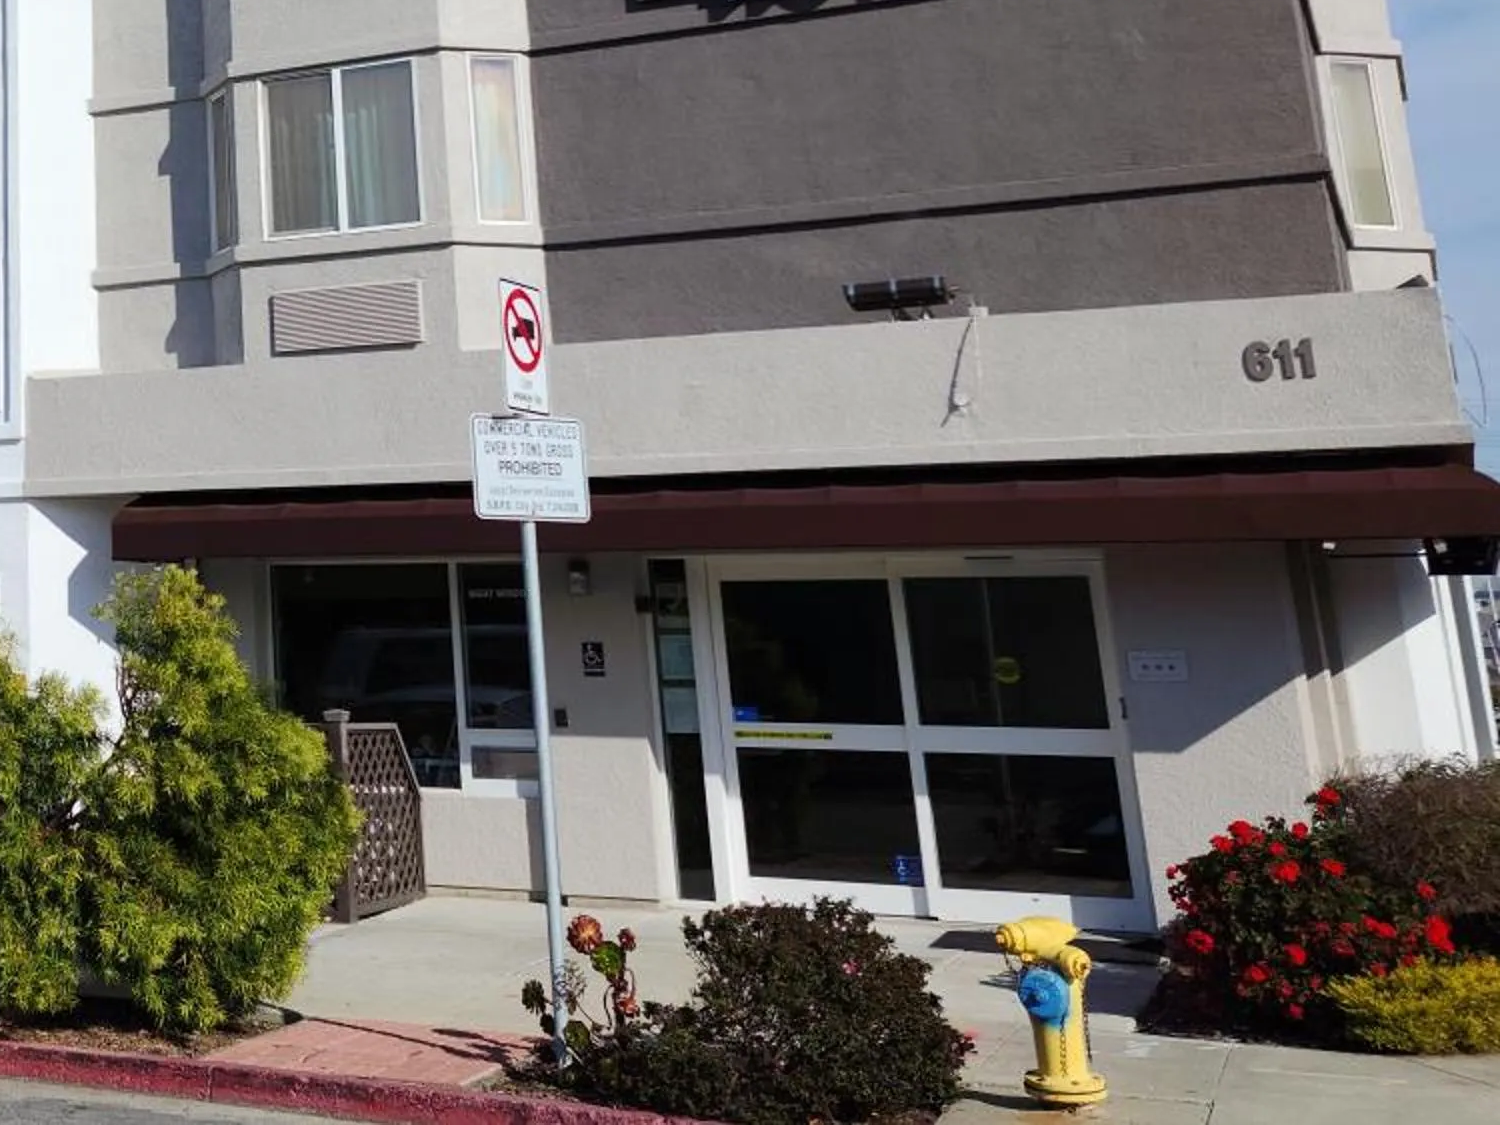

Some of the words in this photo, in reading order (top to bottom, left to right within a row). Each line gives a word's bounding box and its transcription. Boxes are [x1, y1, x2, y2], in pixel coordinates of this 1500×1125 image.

[1241, 337, 1317, 382] 611
[483, 440, 508, 456] OVER
[498, 460, 563, 476] PROHIBITED
